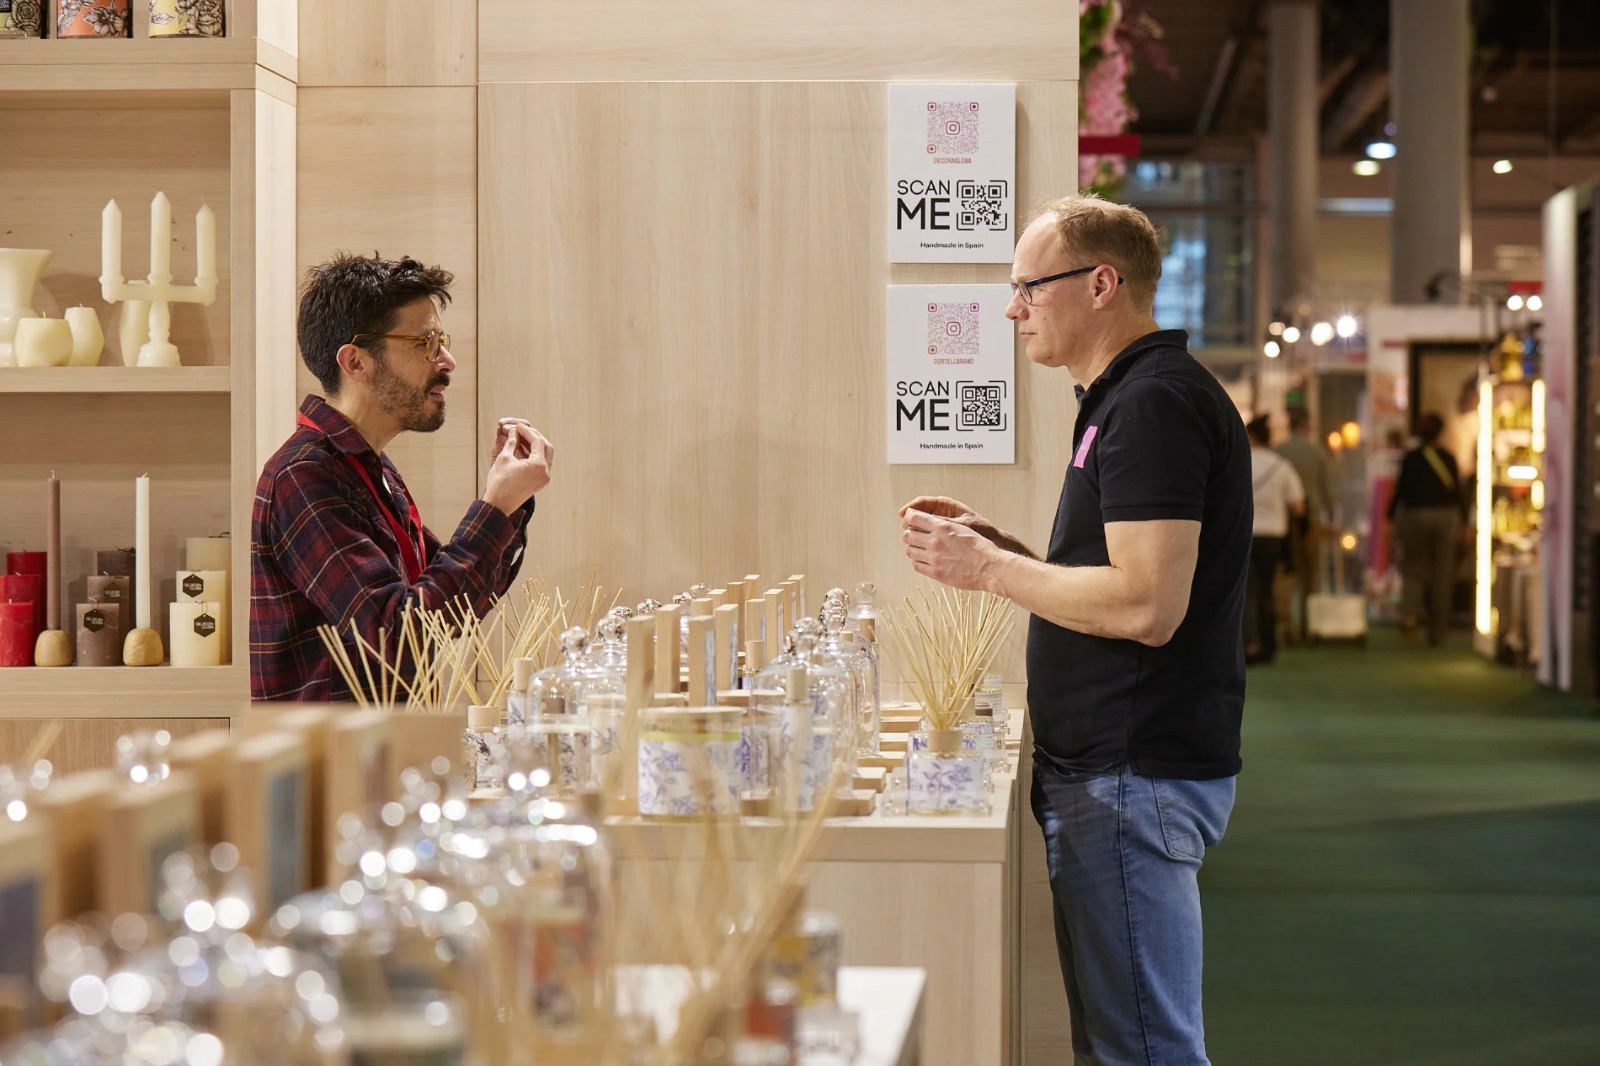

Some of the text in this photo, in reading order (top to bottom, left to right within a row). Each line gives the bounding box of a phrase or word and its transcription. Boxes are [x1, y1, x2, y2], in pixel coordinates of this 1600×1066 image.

[897, 180, 950, 195] SCAN
[897, 198, 950, 230] ME
[896, 381, 950, 396] SCAN
[896, 399, 950, 431] ME
